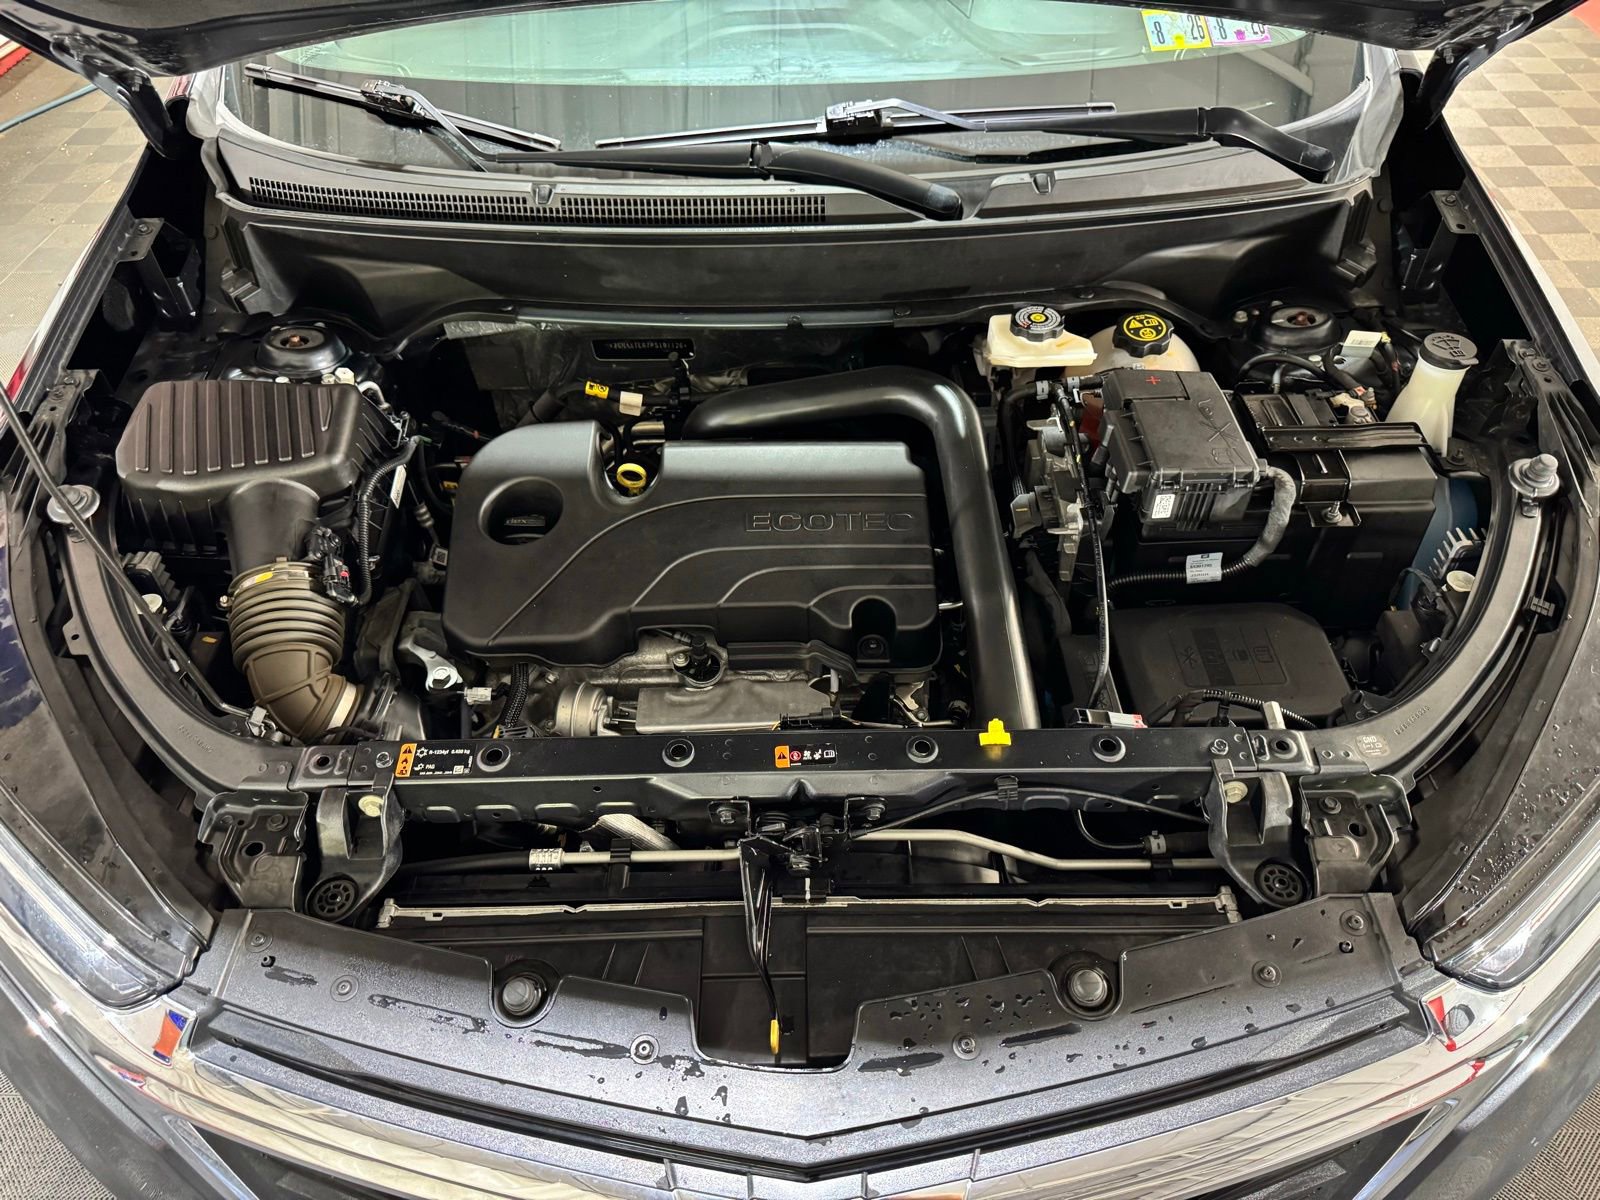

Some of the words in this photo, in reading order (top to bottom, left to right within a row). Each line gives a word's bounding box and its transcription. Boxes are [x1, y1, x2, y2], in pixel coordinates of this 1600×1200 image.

[1153, 21, 1165, 44] 8
[1187, 15, 1205, 40] 26
[1216, 18, 1228, 40] 8
[745, 512, 915, 532] ECOTEC
